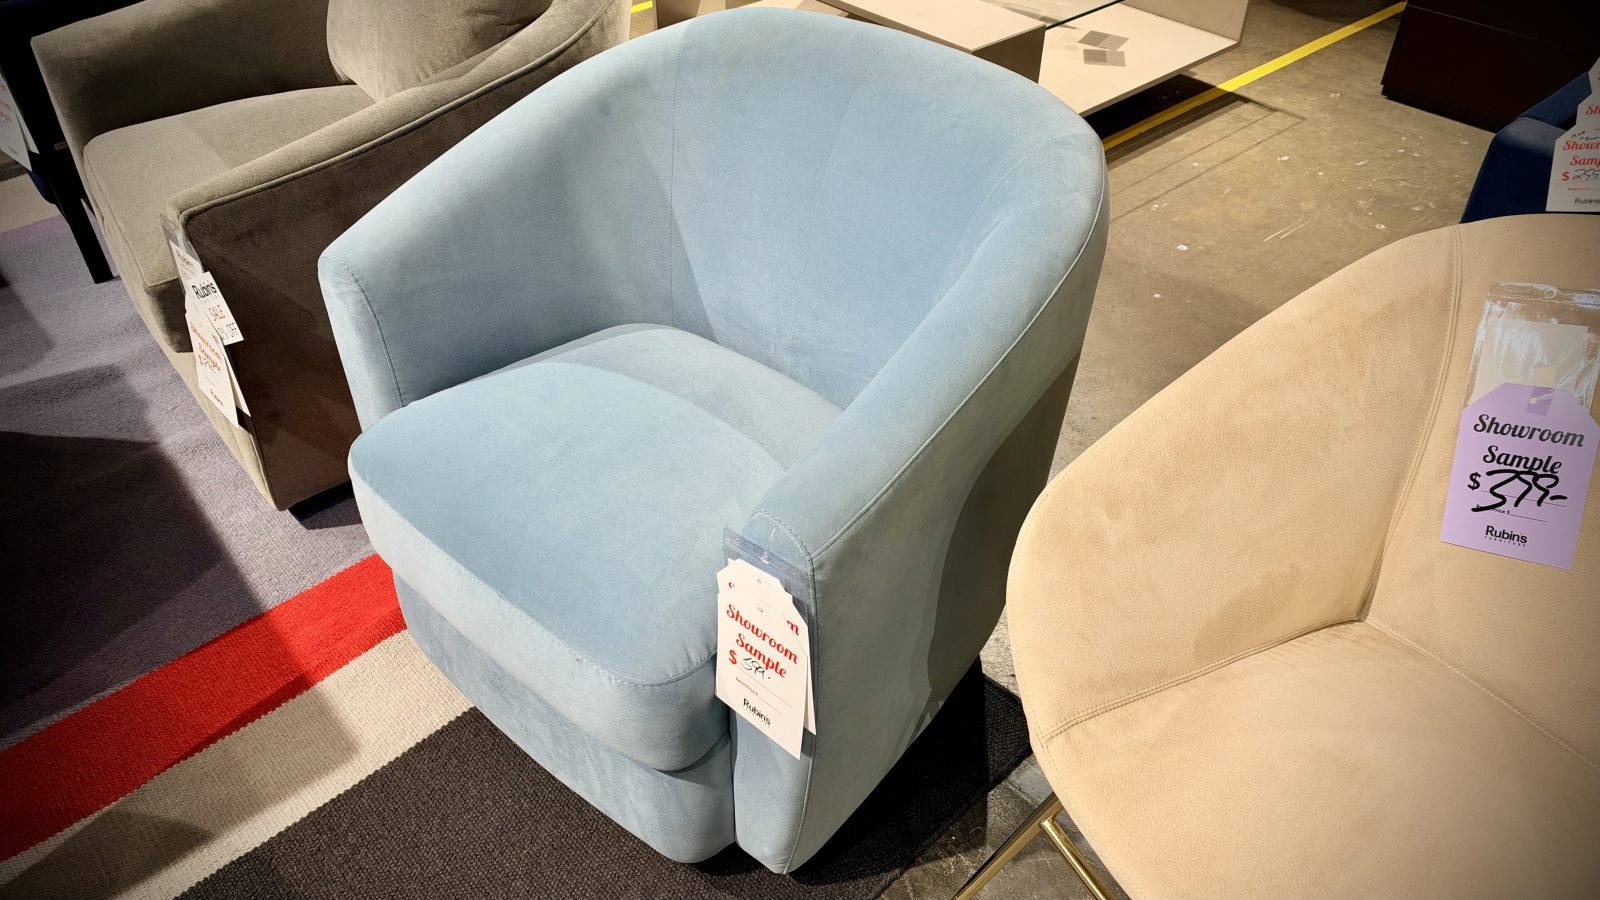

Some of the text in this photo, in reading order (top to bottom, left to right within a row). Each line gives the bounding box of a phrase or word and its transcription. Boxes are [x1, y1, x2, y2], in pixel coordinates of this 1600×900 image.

[1562, 171, 1570, 182] $
[208, 304, 226, 321] SALE
[226, 322, 239, 338] OFF
[1473, 413, 1585, 448] Showroom
[1482, 444, 1562, 474] Sample
[1467, 471, 1482, 491] $
[726, 603, 798, 665] Showroom
[728, 649, 738, 665] $
[735, 632, 787, 678] Sample
